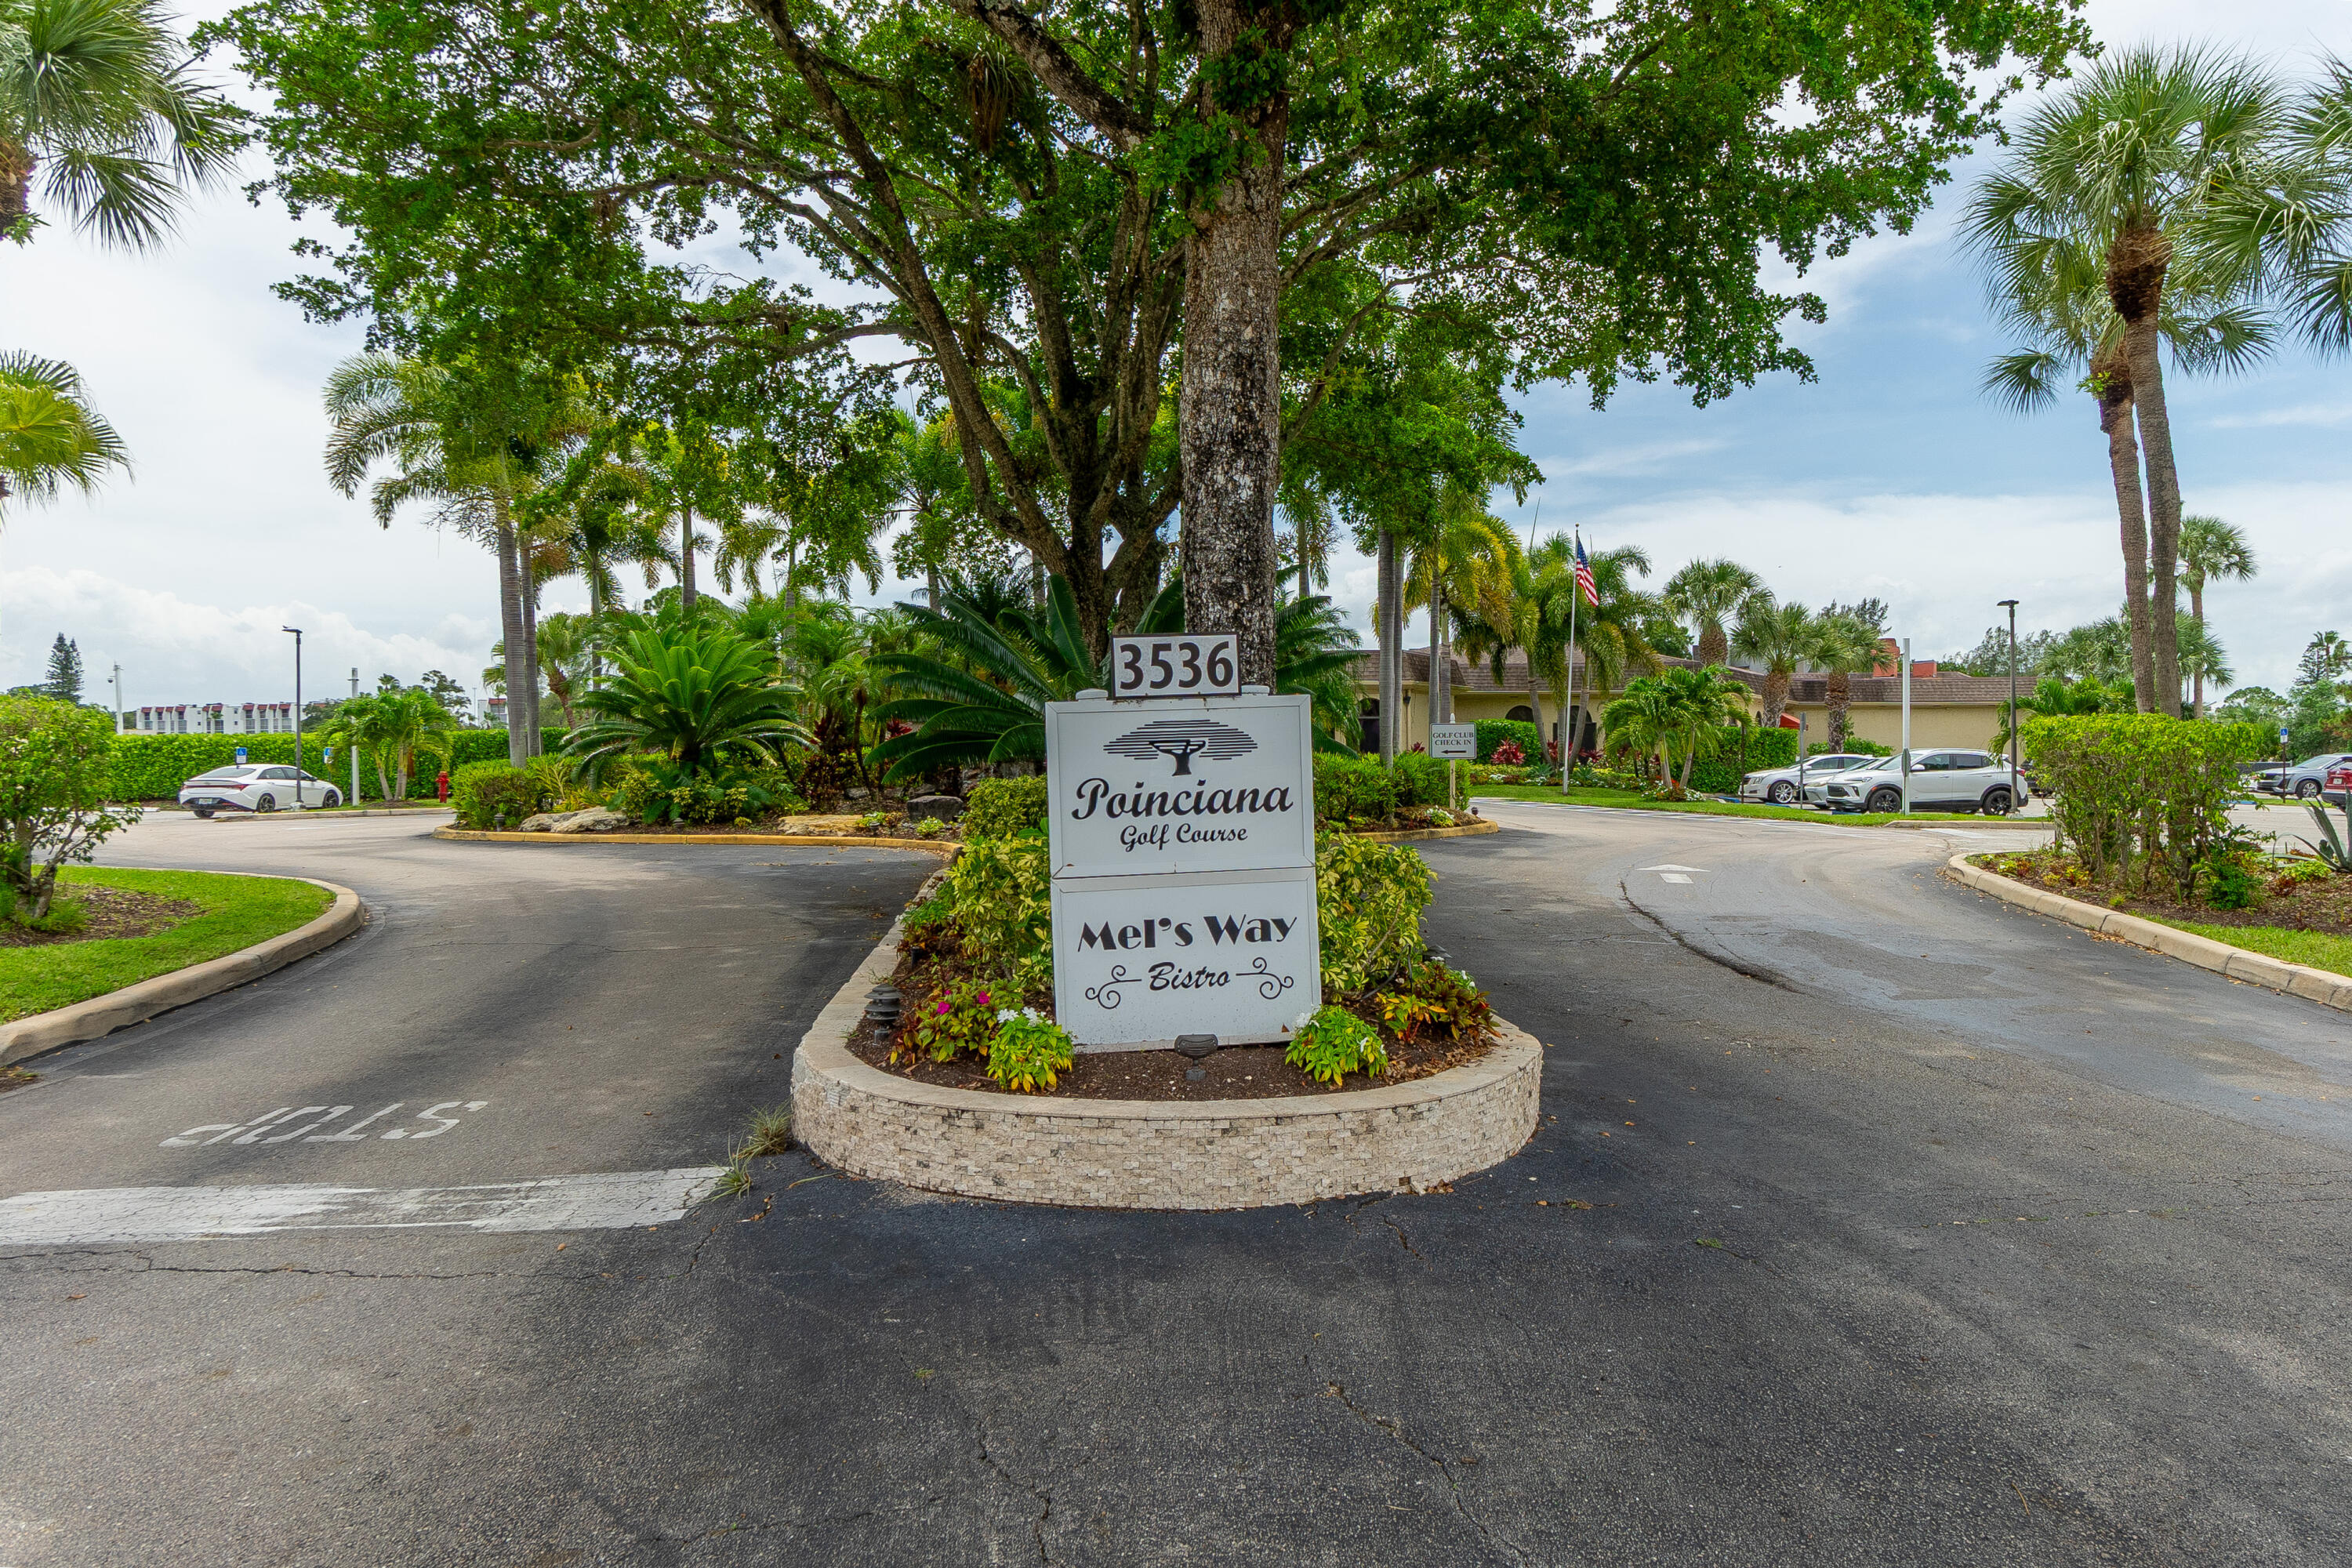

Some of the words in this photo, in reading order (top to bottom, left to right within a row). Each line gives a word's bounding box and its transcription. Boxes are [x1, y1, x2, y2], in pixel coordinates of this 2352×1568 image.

[1119, 641, 1234, 691] 3536
[1071, 777, 1294, 821] Poinciana
[1120, 824, 1170, 852] Golf
[1175, 823, 1248, 844] Course
[1077, 916, 1193, 953] Mel's
[1203, 913, 1298, 946] Way
[1148, 961, 1231, 991] Bistro
[158, 1101, 489, 1148] STOP
